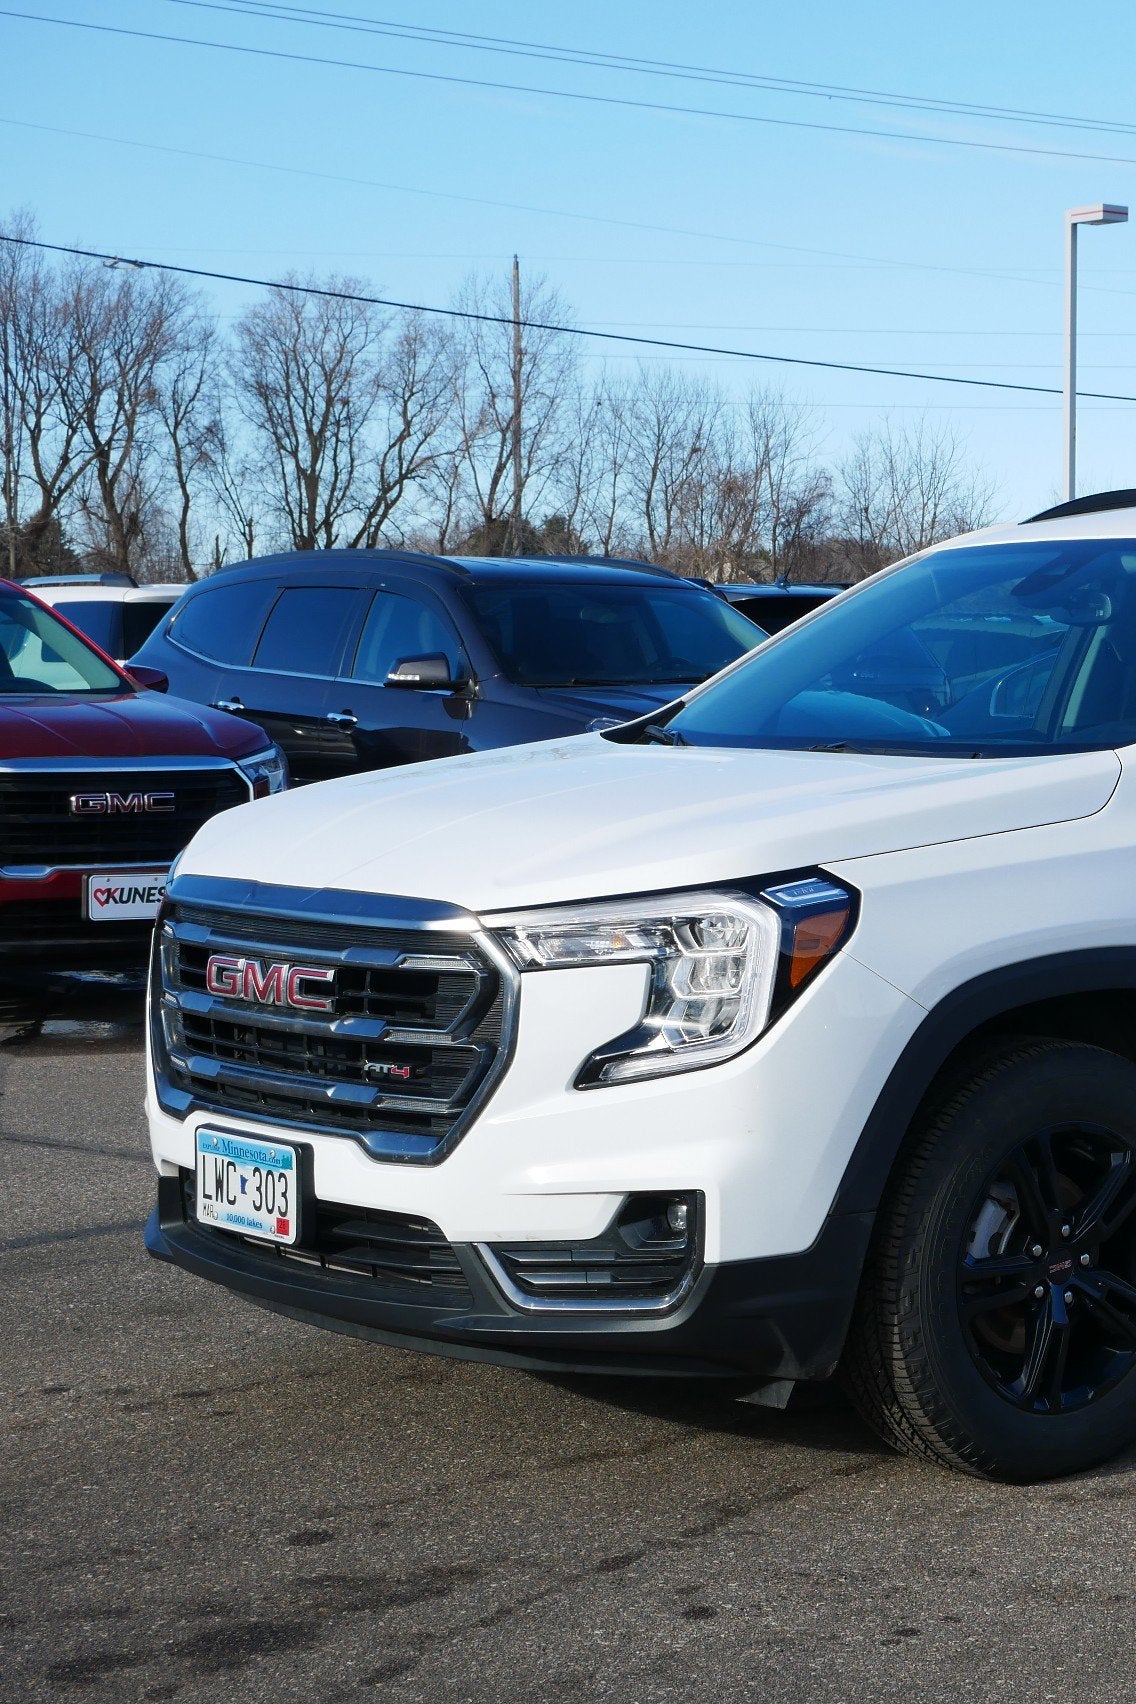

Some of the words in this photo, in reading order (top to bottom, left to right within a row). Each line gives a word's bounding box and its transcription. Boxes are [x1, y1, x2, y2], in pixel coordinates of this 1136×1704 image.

[70, 792, 175, 814] GMC
[206, 954, 337, 1013] GMC
[363, 1062, 410, 1079] AT4
[202, 1154, 237, 1206] LWC
[252, 1166, 289, 1218] 303
[246, 1216, 263, 1229] lakes
